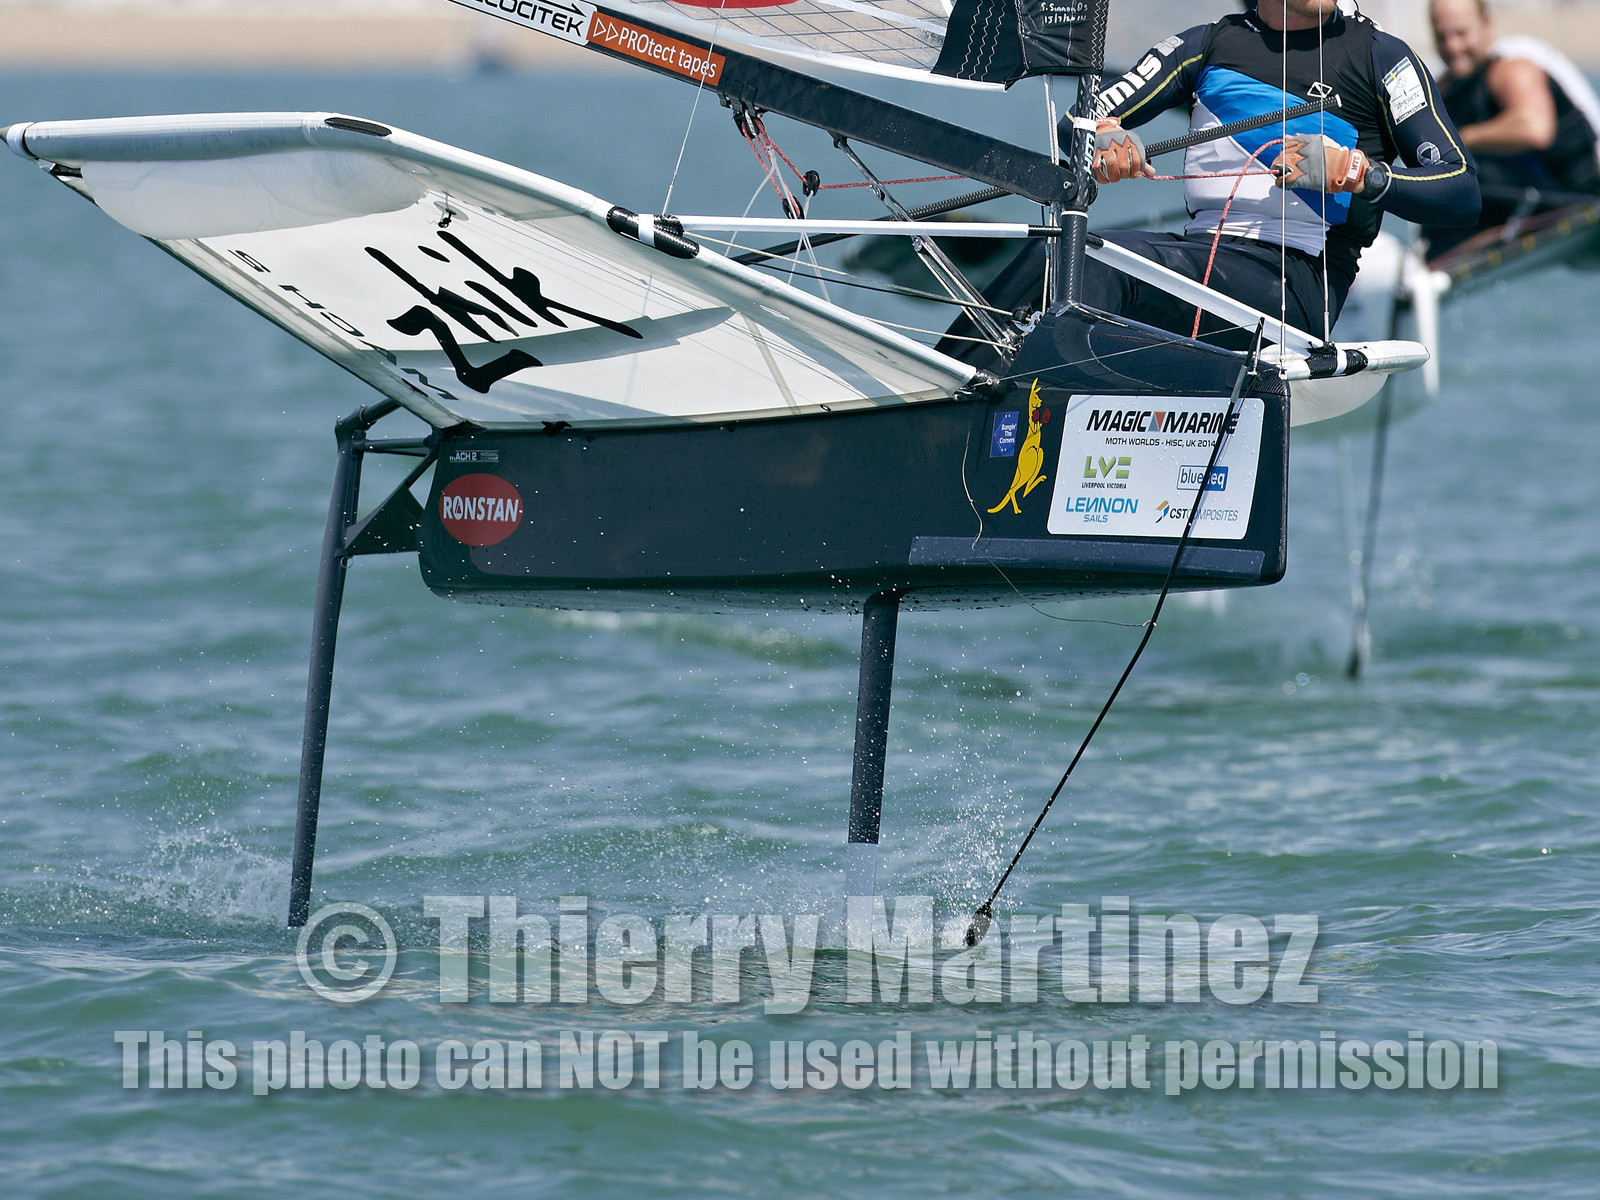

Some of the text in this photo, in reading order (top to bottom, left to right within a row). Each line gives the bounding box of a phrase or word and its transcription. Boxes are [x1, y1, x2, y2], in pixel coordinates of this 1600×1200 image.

[618, 26, 718, 80] PROtect tapes
[364, 230, 644, 394] zhik
[1086, 410, 1152, 432] MAGIC
[1105, 437, 1127, 446] MOTH
[1128, 438, 1160, 446] WORLDS
[1197, 440, 1216, 448] 2014
[443, 495, 519, 522] RONSTAN
[1083, 514, 1108, 523] SAILS
